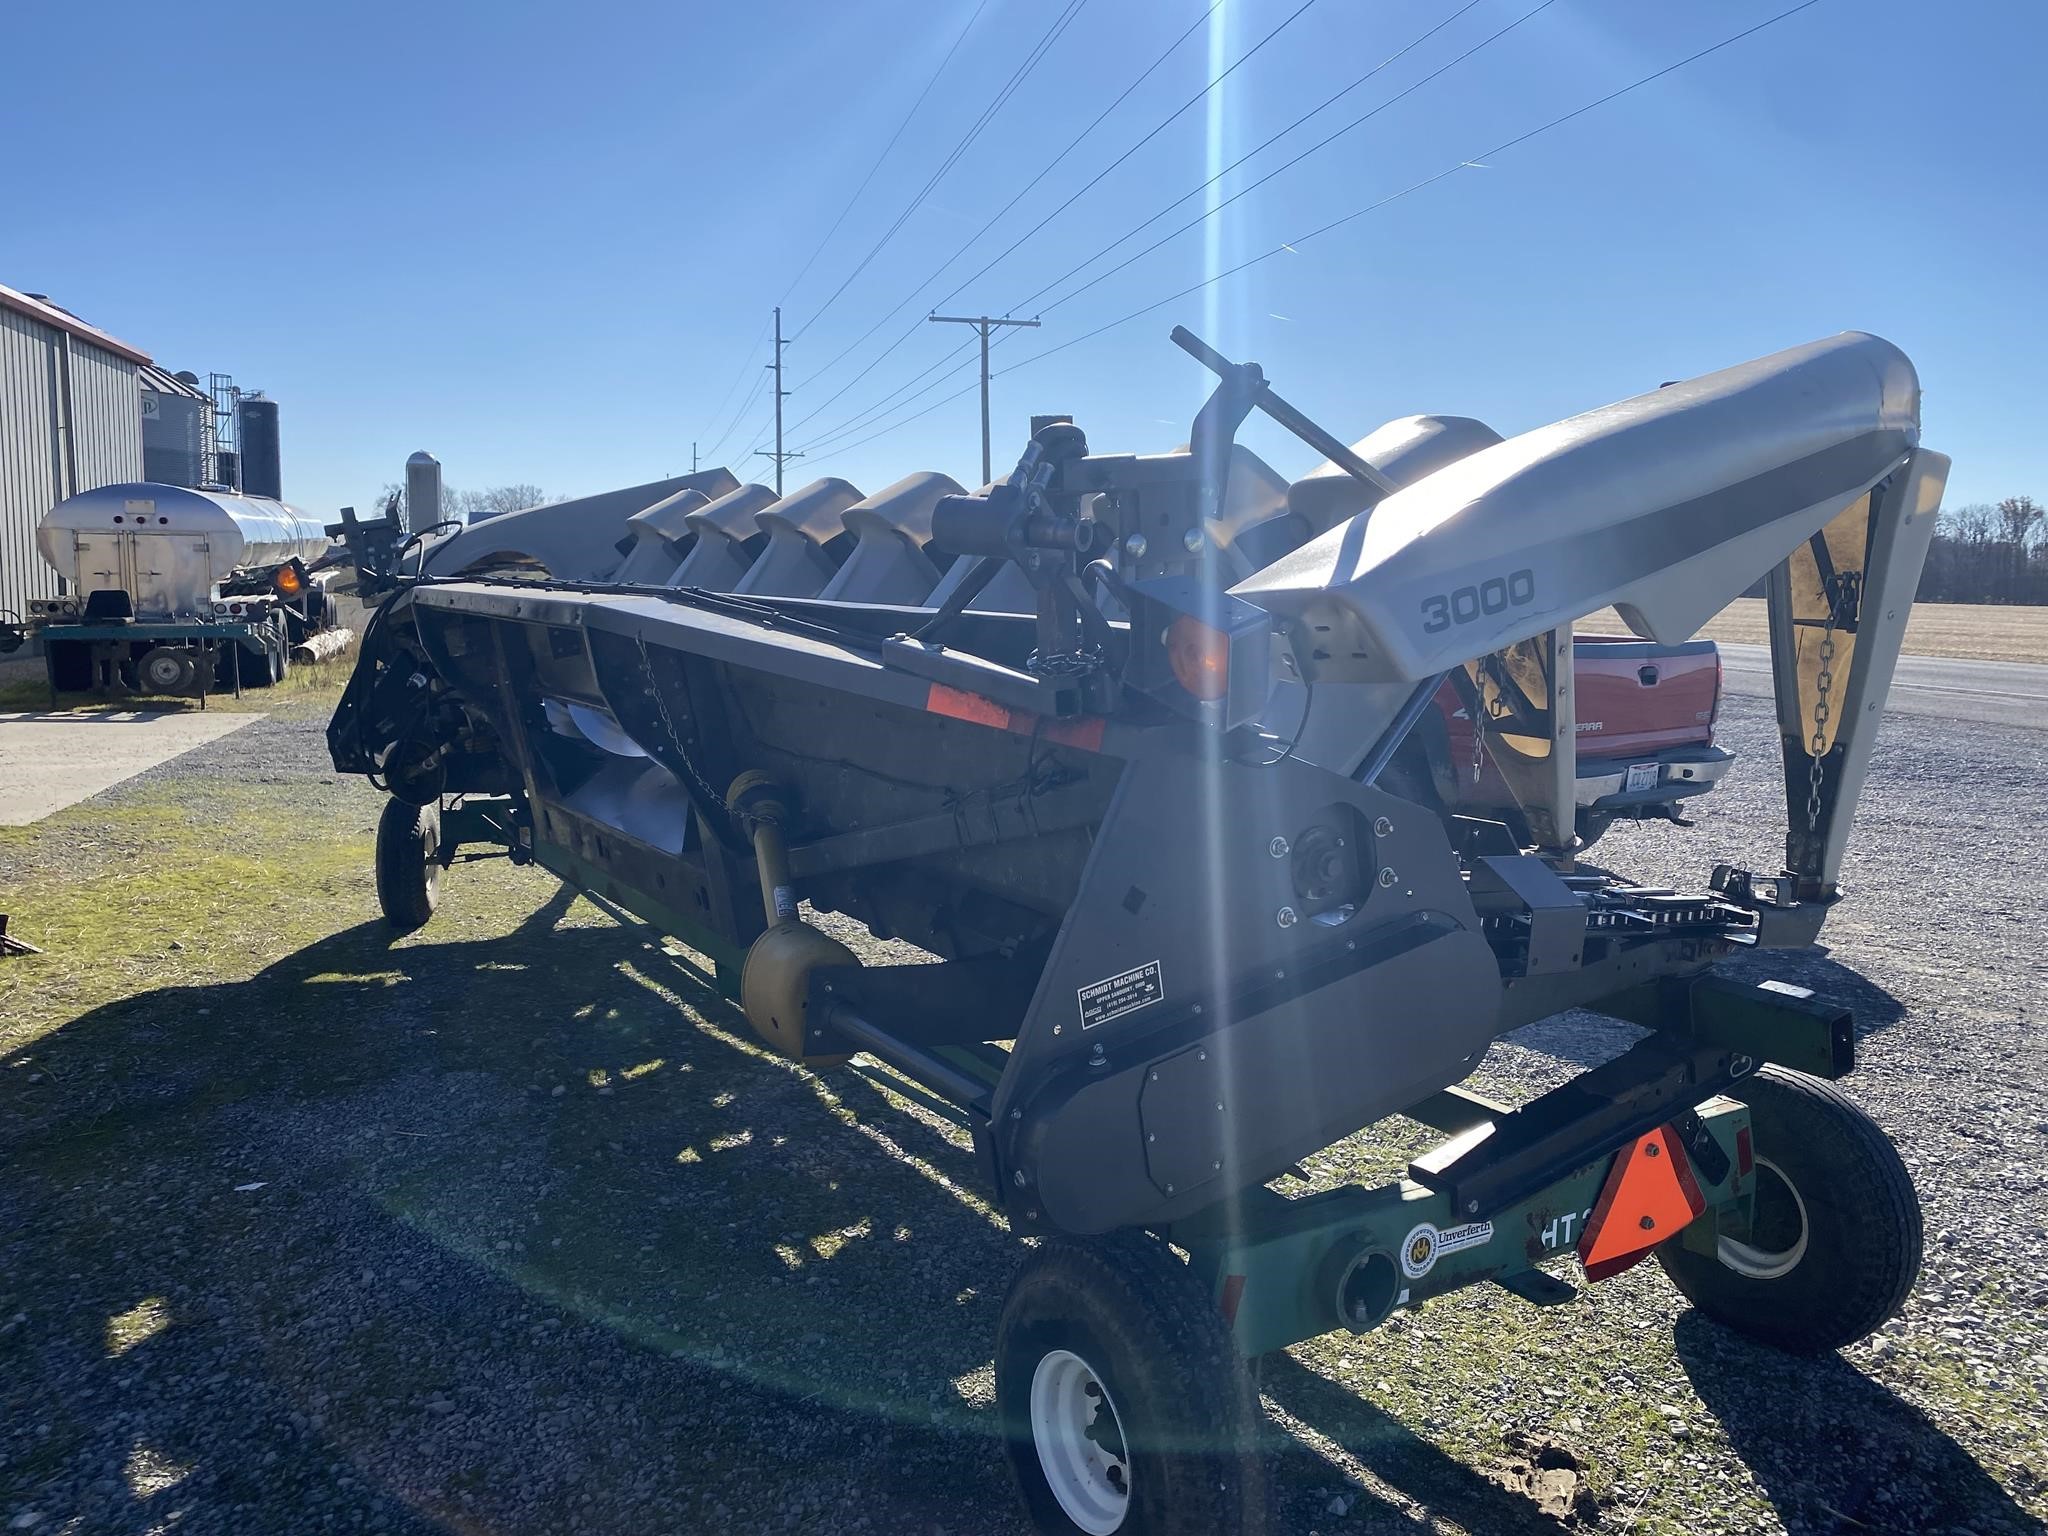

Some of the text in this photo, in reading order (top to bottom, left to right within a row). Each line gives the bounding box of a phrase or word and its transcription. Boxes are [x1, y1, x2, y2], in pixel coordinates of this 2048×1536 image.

[1420, 568, 1535, 634] 3000
[1575, 721, 1603, 732] ERRA
[1081, 966, 1157, 1001] SCHMIDT MACHINE CO.
[1096, 993, 1111, 1004] UPPER
[1438, 1222, 1491, 1244] Unverferth
[1541, 1212, 1577, 1250] HT
